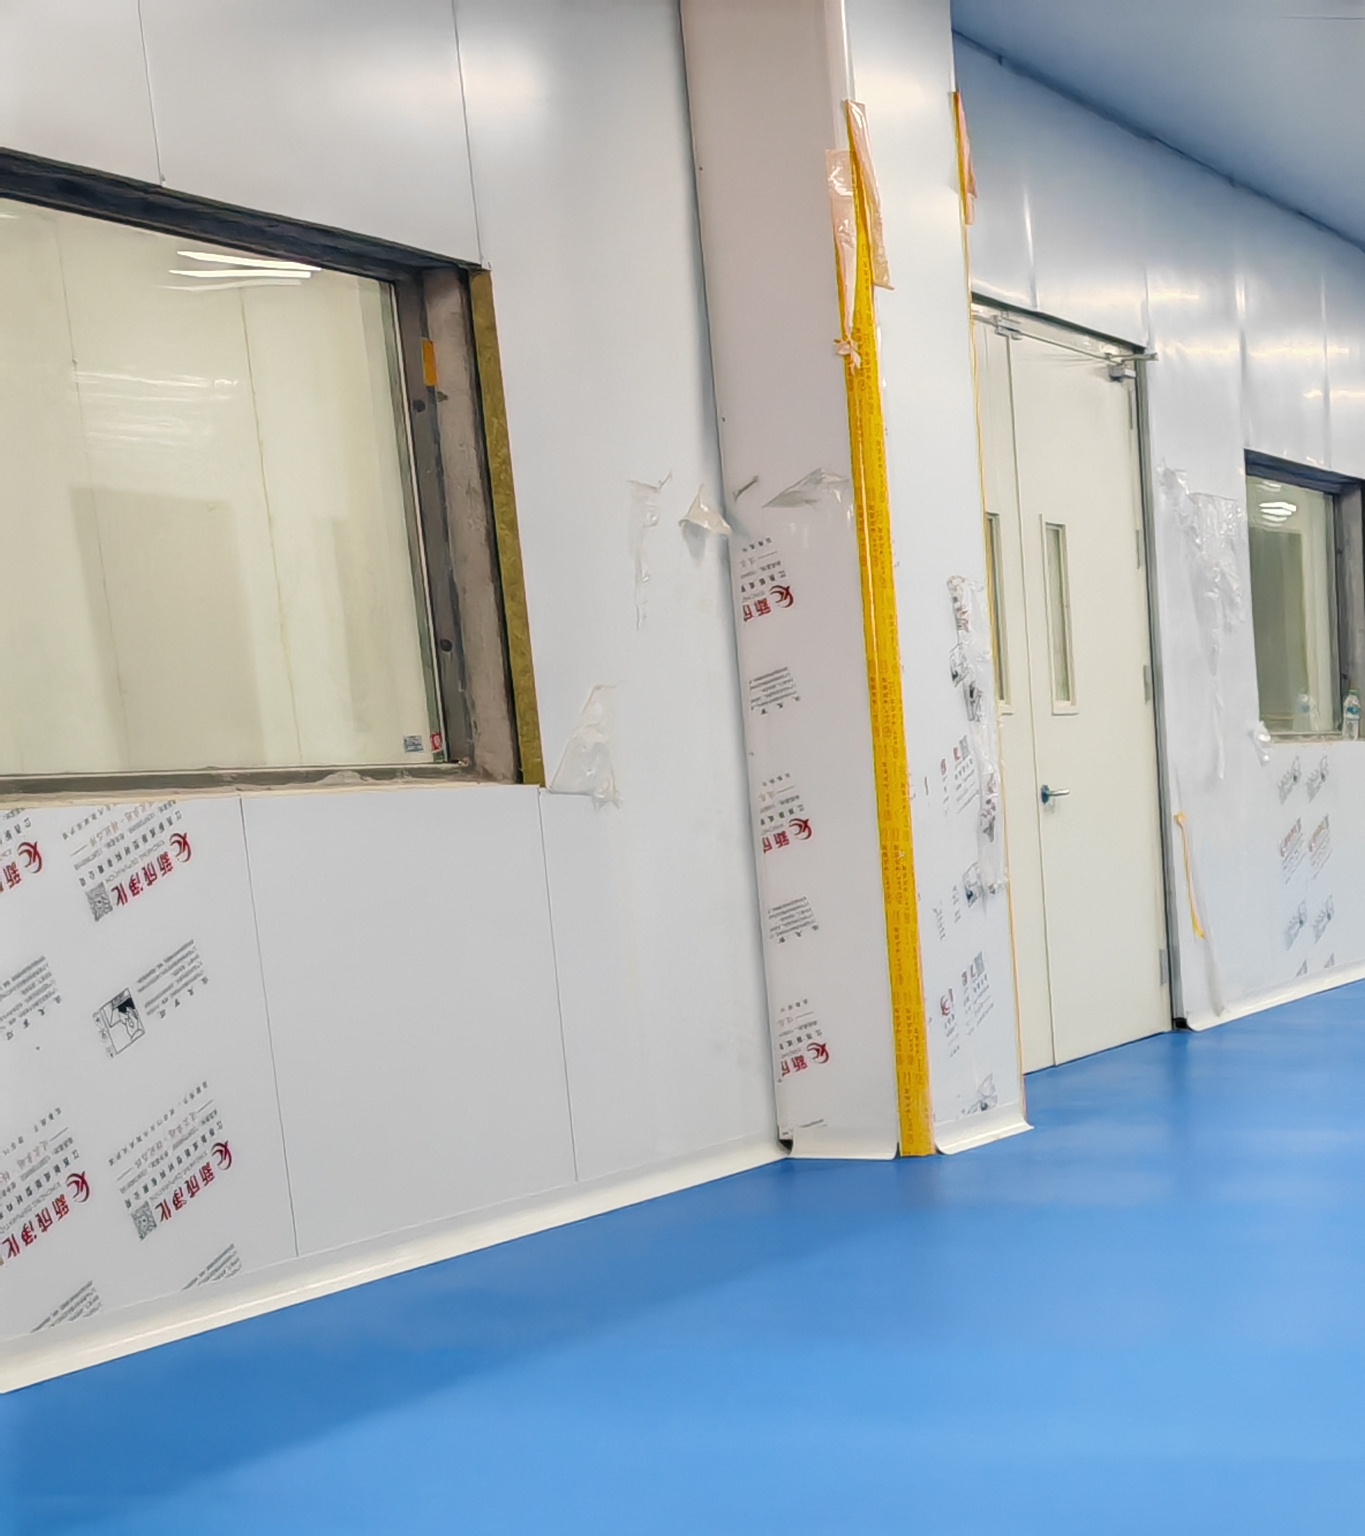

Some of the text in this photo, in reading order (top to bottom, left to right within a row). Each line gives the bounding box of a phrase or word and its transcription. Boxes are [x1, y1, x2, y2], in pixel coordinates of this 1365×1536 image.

[110, 851, 175, 907] 新成净化
[155, 1161, 216, 1223] 新成净化
[1, 1193, 71, 1259] 新成净化
